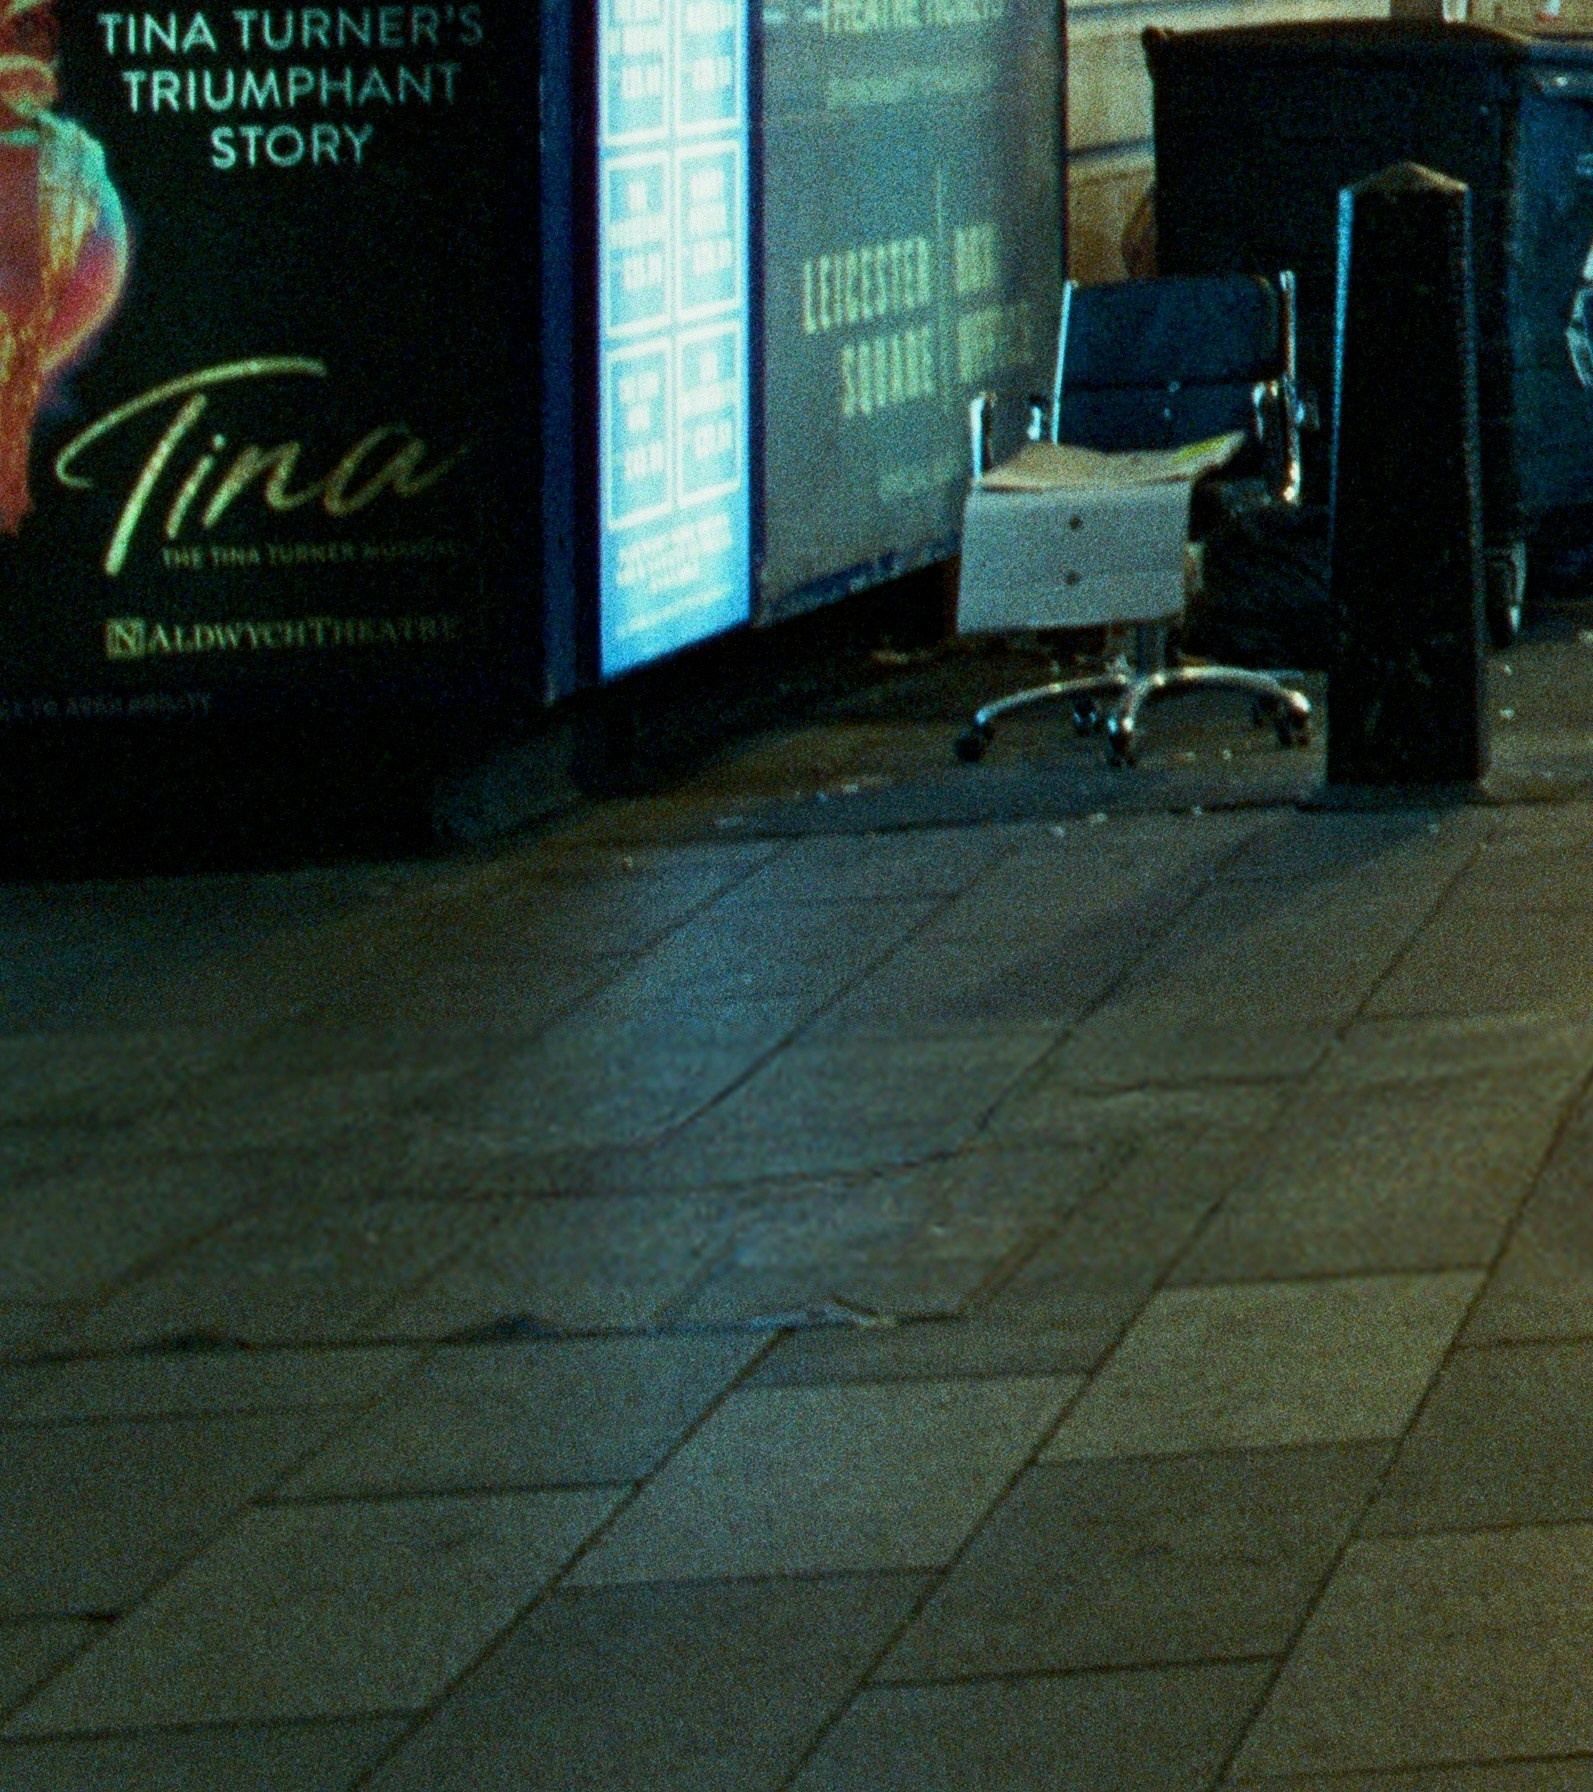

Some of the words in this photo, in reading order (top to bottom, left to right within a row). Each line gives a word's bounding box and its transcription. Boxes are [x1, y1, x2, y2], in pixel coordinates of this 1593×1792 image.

[99, 11, 217, 54] TINA
[234, 3, 484, 52] TURNER'S
[122, 61, 463, 113] TRIUMPHANT
[210, 122, 376, 171] STORY
[803, 234, 932, 335] LEICESTER
[842, 324, 935, 419] SQUARE
[56, 356, 468, 578] Tina
[163, 545, 203, 571] THE
[210, 544, 261, 569] TINA
[267, 542, 355, 567] TURNER
